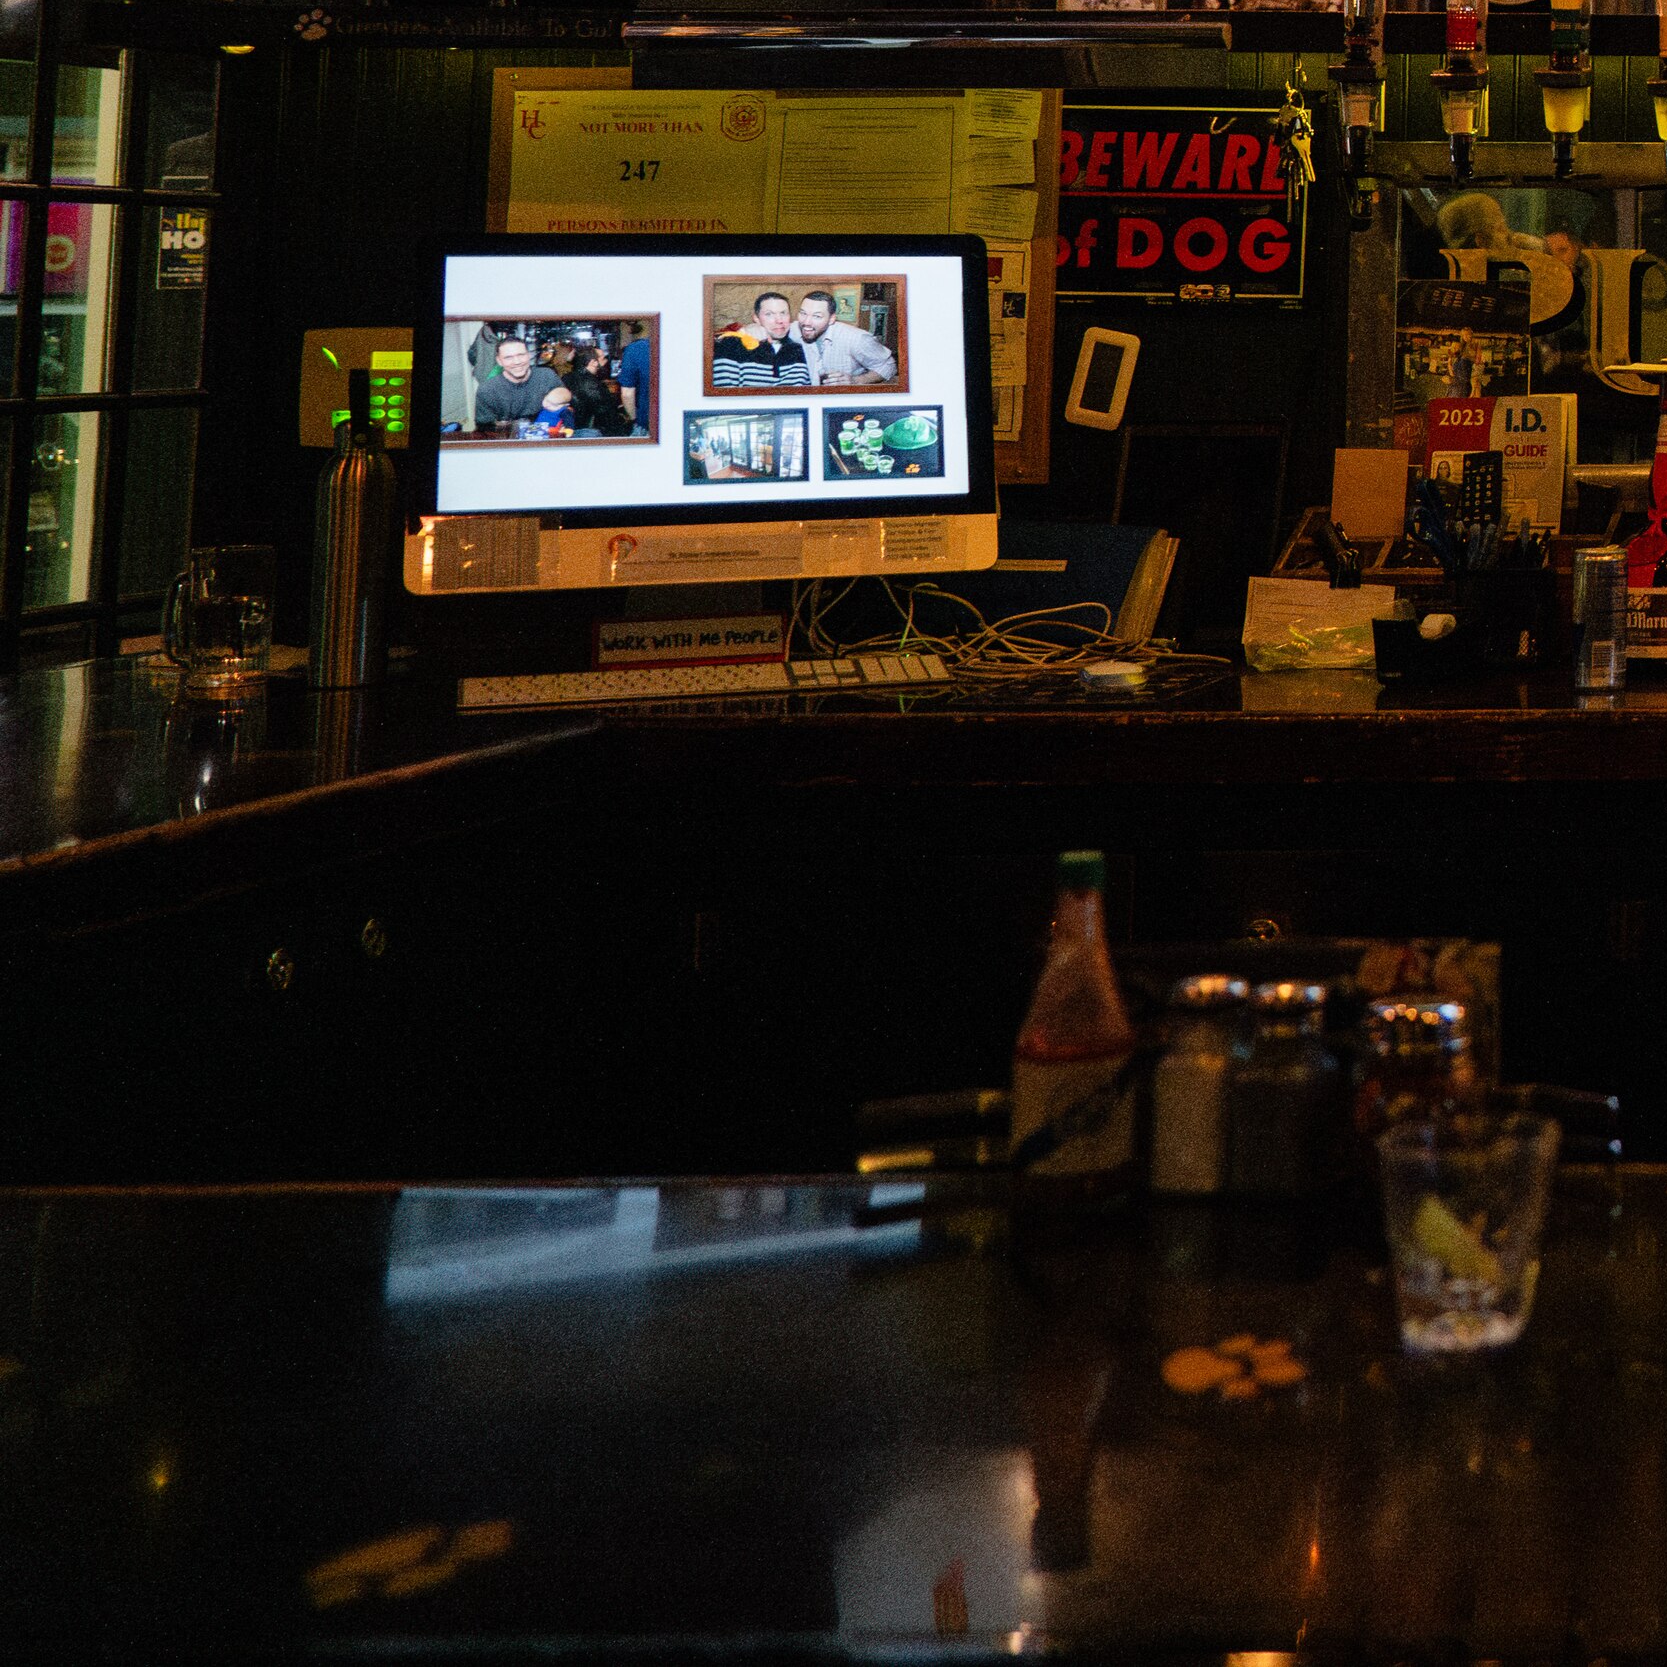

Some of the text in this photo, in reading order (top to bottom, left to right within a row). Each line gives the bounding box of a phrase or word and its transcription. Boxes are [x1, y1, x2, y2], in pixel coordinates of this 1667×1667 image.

[579, 122, 704, 134] NOT MORE THAN
[619, 160, 660, 183] 247
[547, 219, 618, 232] PERSONS
[1116, 216, 1292, 273] DOG
[1439, 409, 1484, 426] 2023
[1505, 408, 1547, 432] I.D.
[1504, 445, 1547, 457] GUIDE
[602, 634, 647, 651] WORK
[653, 632, 693, 649] WITH
